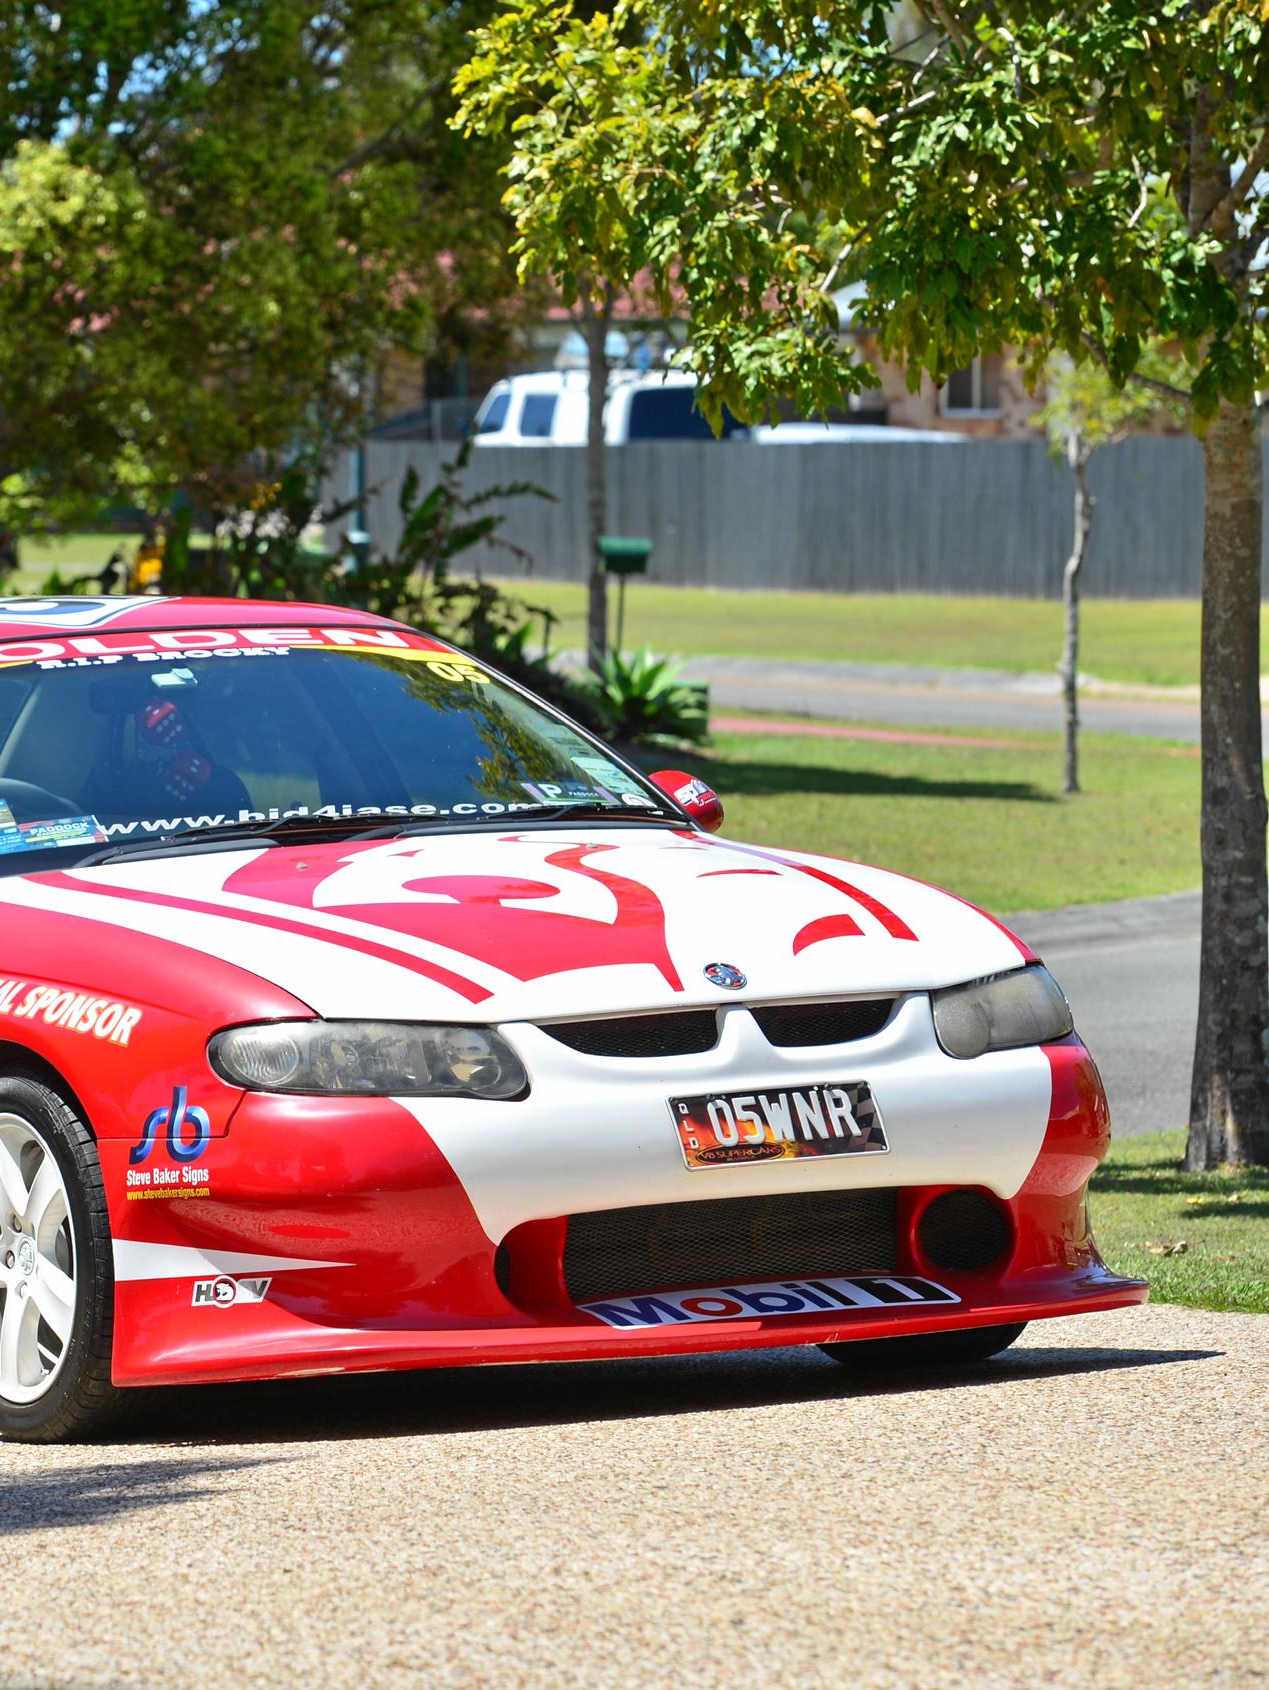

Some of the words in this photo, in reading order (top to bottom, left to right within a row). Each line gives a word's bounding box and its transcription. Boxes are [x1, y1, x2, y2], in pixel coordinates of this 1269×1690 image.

[133, 647, 291, 662] BROCKY
[426, 662, 491, 684] 05
[30, 821, 90, 836] PADDOCK
[13, 985, 143, 1049] SPONSOR
[706, 1088, 863, 1148] 05WNR
[716, 1146, 783, 1160] SUPERCARS
[126, 1169, 151, 1186] Steve
[153, 1167, 181, 1185] Baker
[182, 1165, 209, 1186] Signs
[126, 1186, 211, 1201] www.stevebakersigns.com
[588, 1281, 860, 1327] Mobil
